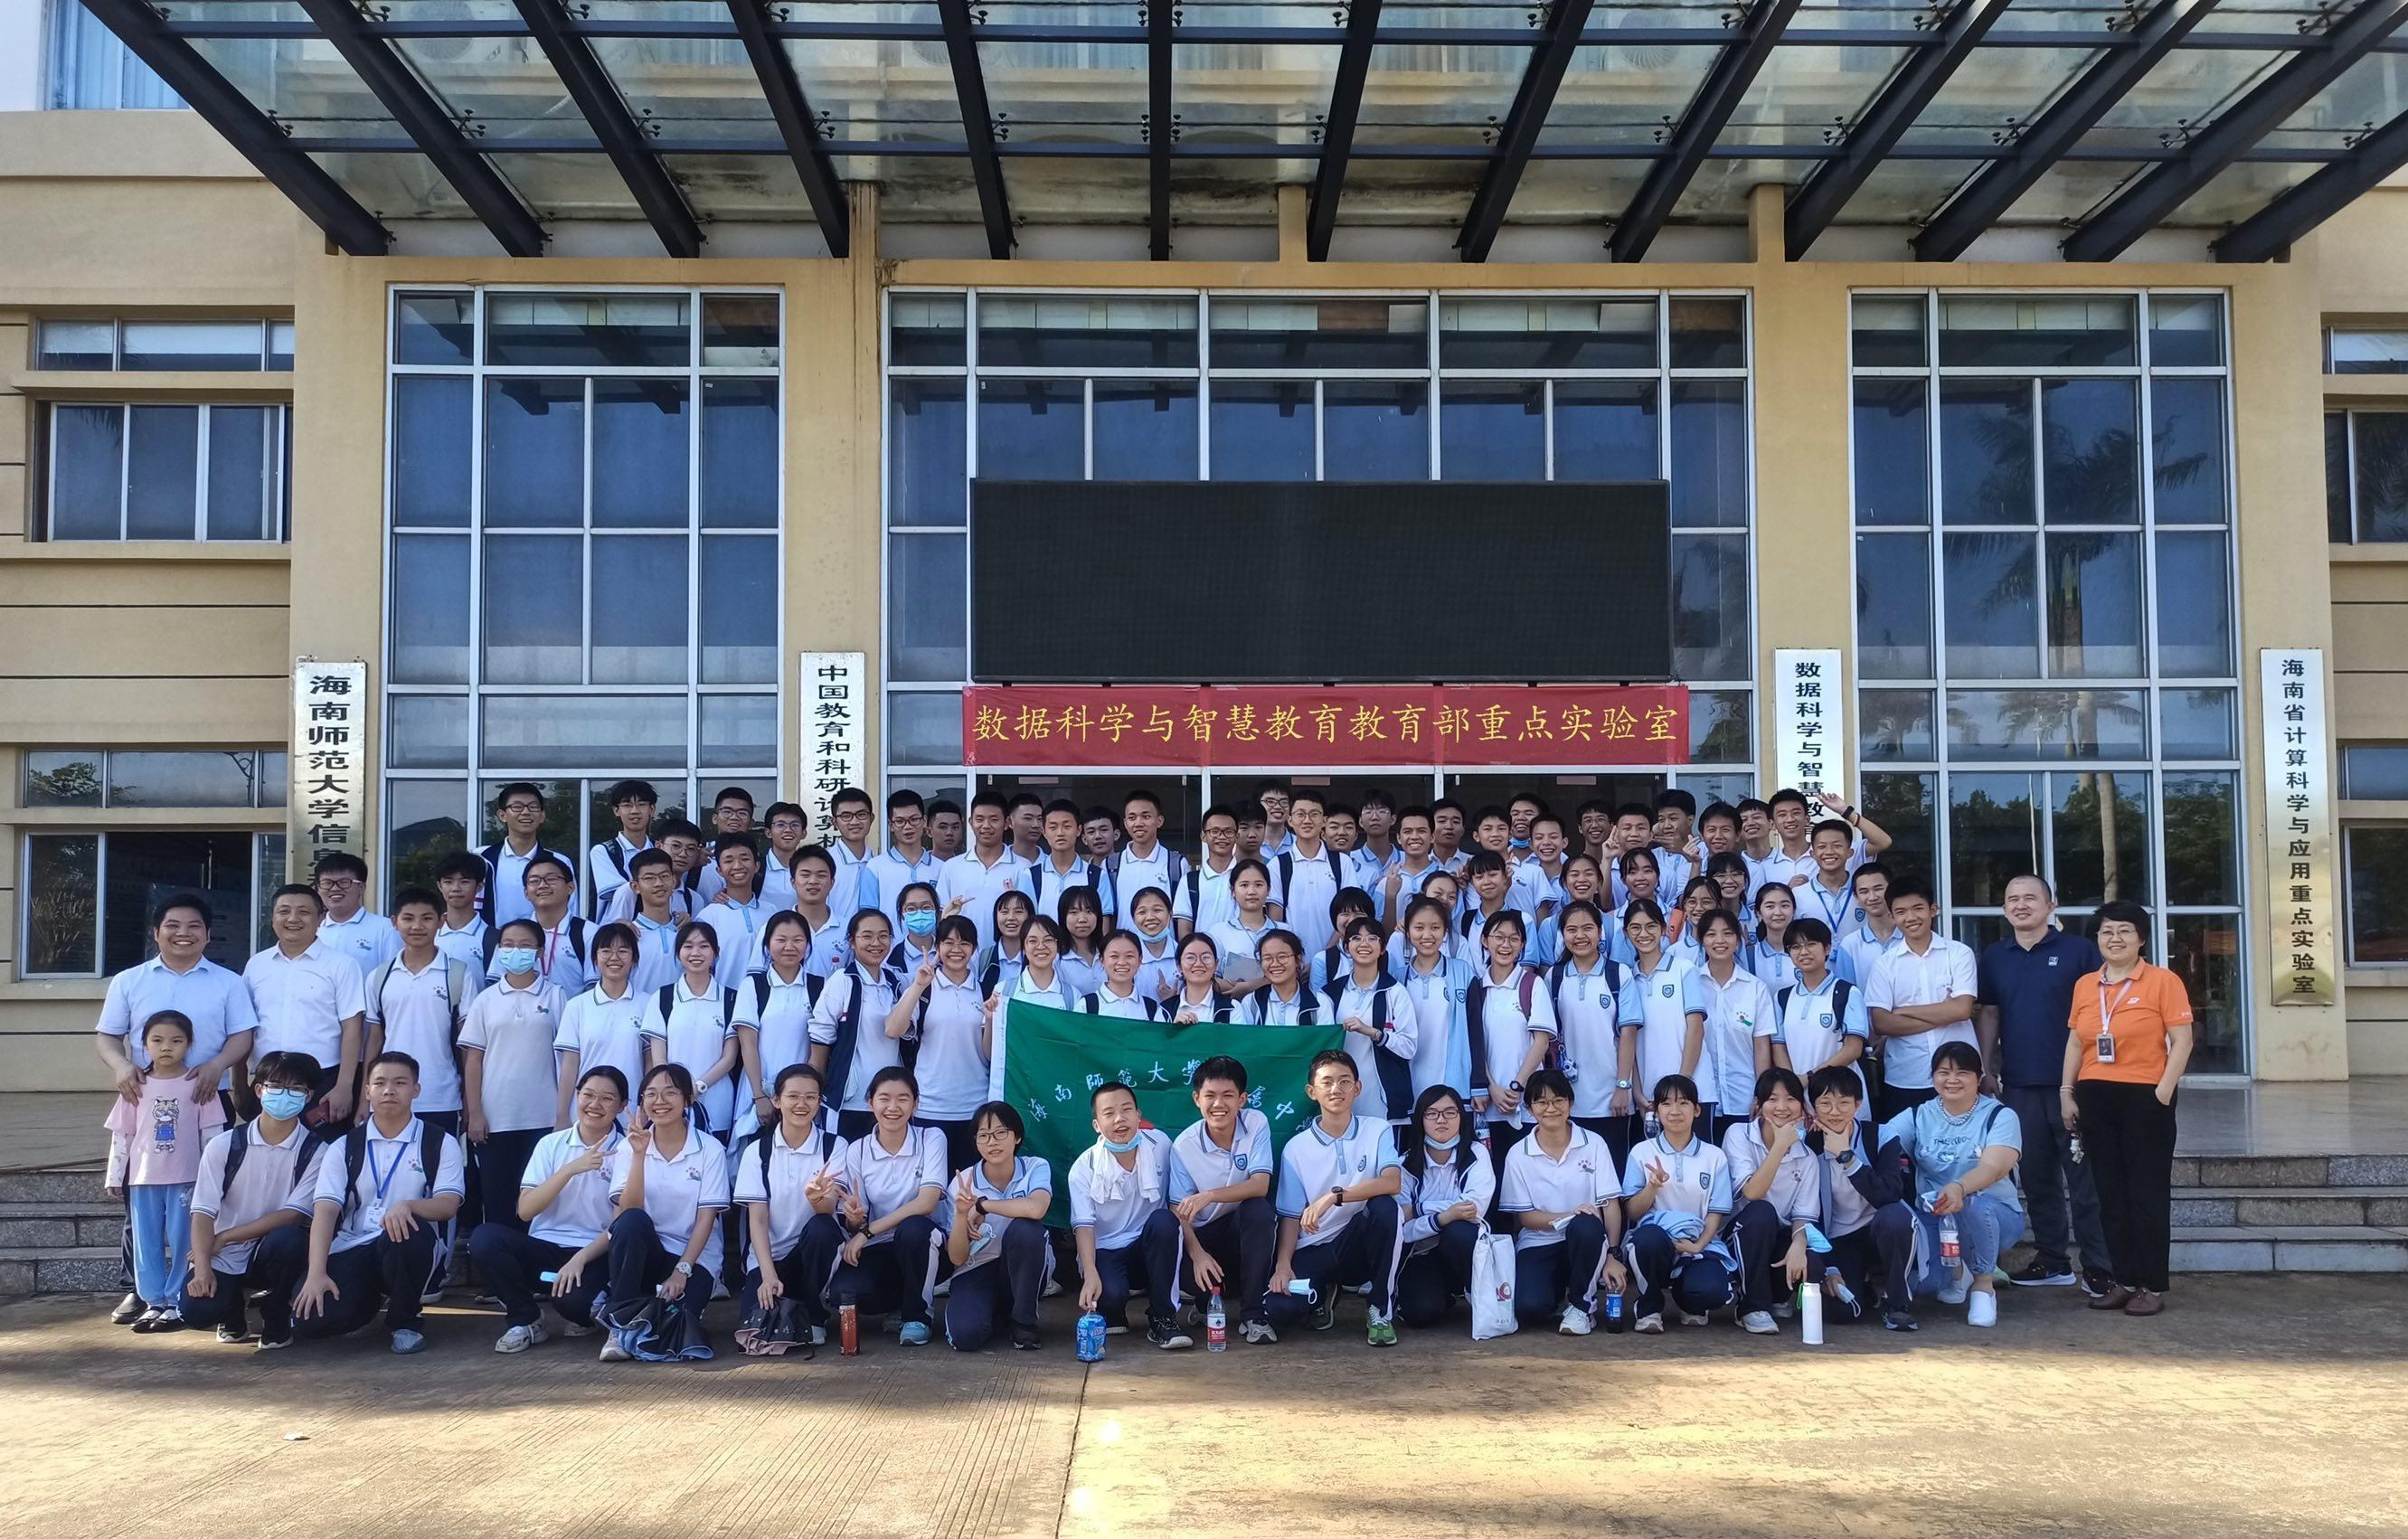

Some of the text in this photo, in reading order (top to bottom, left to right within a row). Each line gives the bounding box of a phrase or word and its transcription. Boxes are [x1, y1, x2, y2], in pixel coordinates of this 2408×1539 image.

[307, 675, 352, 885] 海南师范大学信
[971, 703, 1678, 744] 数据科学与智慧教育教育部重点实验室
[1795, 662, 1825, 834] 数据科学与智慧教
[2281, 659, 2317, 994] 海南省计算科学与应用重点实验室
